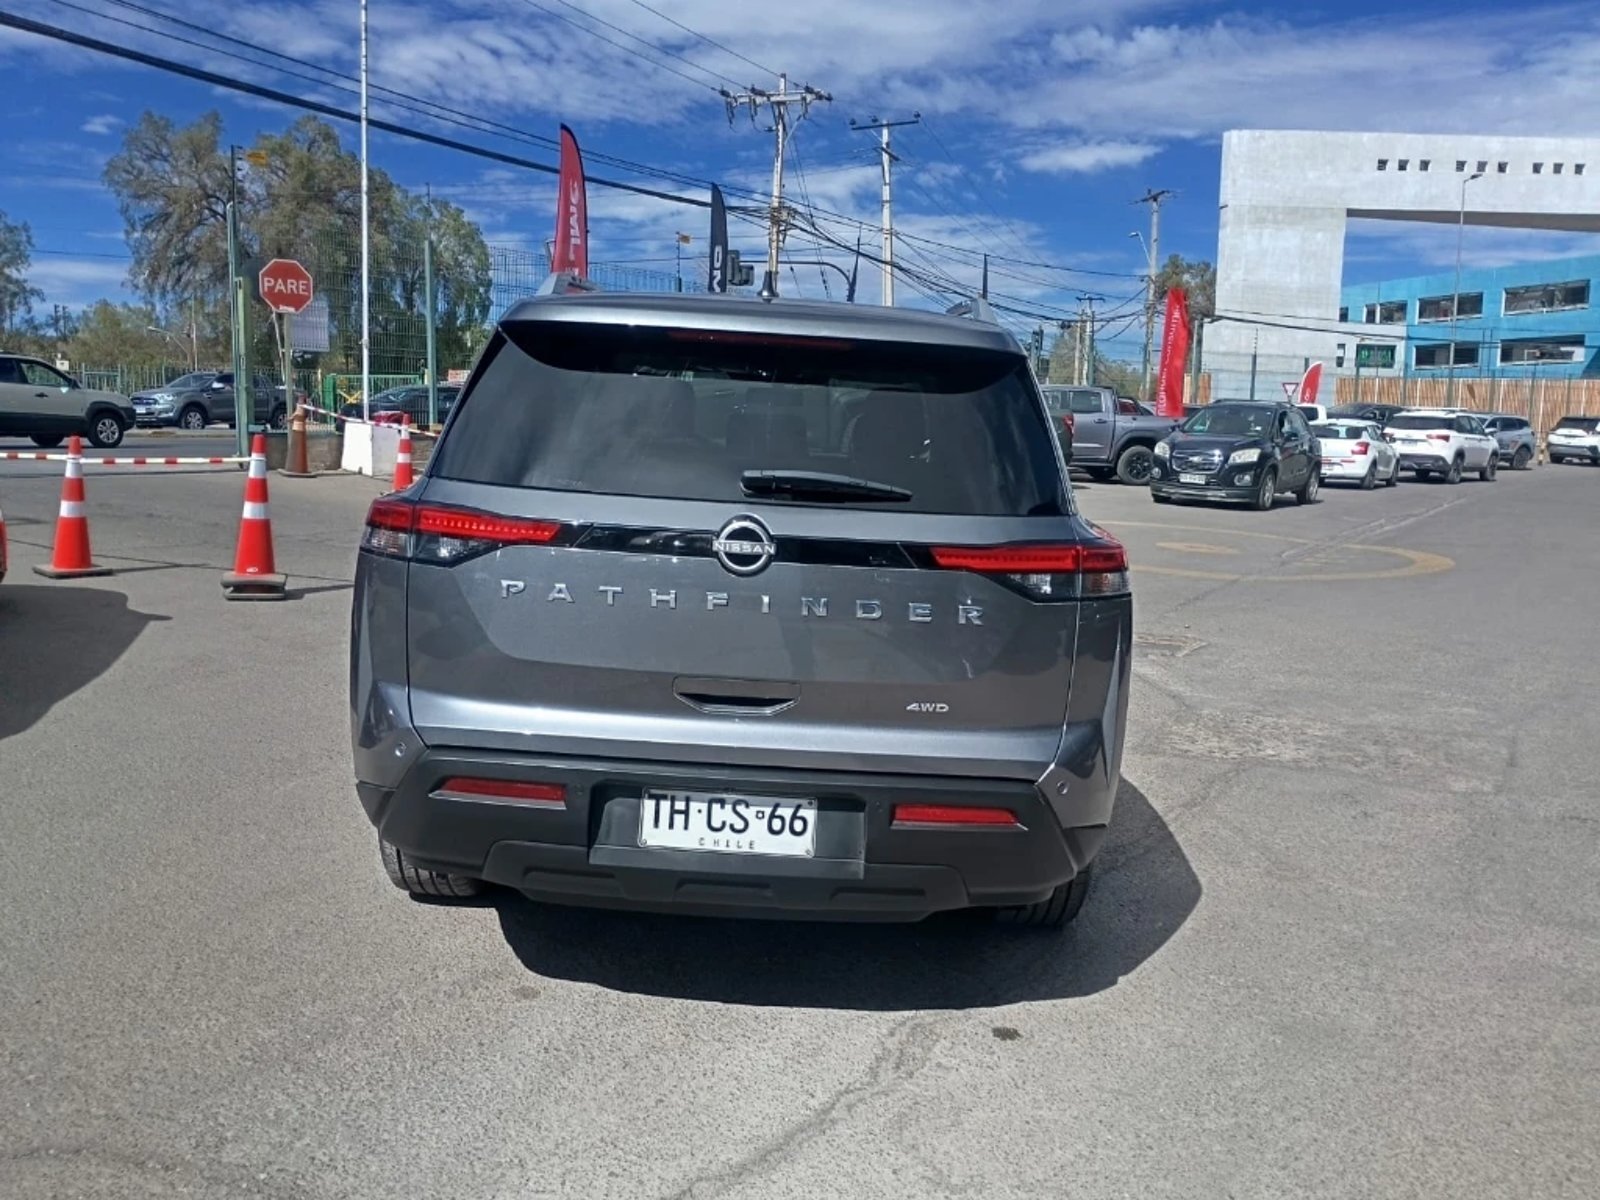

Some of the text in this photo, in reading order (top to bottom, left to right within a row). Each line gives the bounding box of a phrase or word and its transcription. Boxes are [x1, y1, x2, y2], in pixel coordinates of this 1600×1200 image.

[263, 277, 309, 295] PARE
[712, 541, 776, 555] NISSAN
[500, 579, 985, 625] PATHFINDER
[906, 702, 949, 713] 4WD
[698, 837, 756, 849] CHILE
